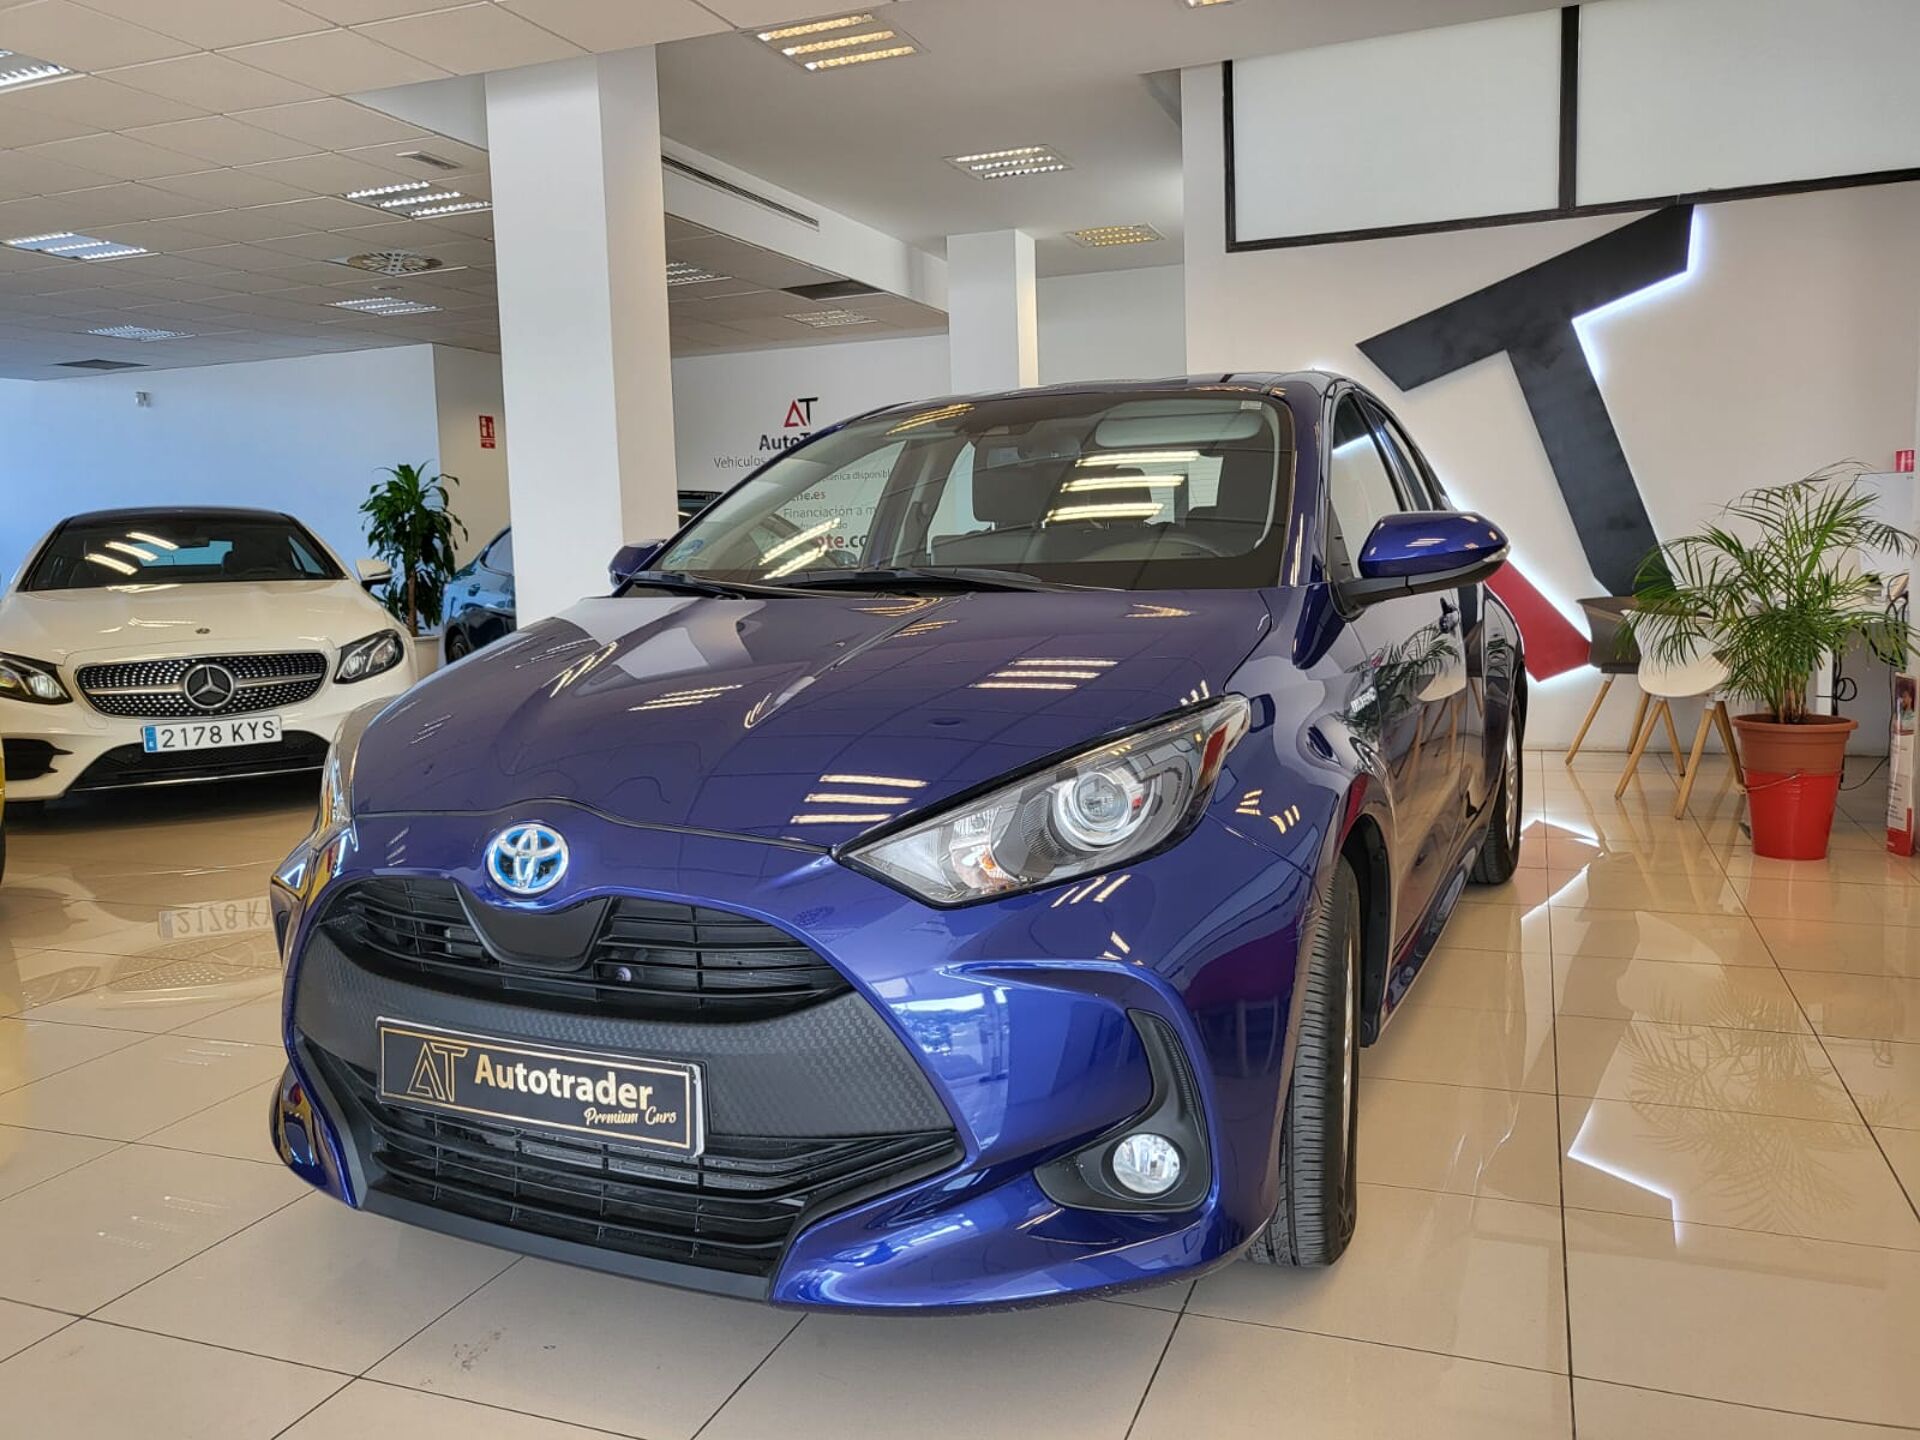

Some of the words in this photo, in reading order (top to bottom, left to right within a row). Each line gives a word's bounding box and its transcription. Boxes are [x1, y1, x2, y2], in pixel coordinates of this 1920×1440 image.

[161, 726, 222, 748] 2178
[231, 720, 275, 742] KYS
[474, 1054, 653, 1110] Autotrader
[584, 1107, 639, 1126] Premium
[644, 1105, 677, 1125] Cars
